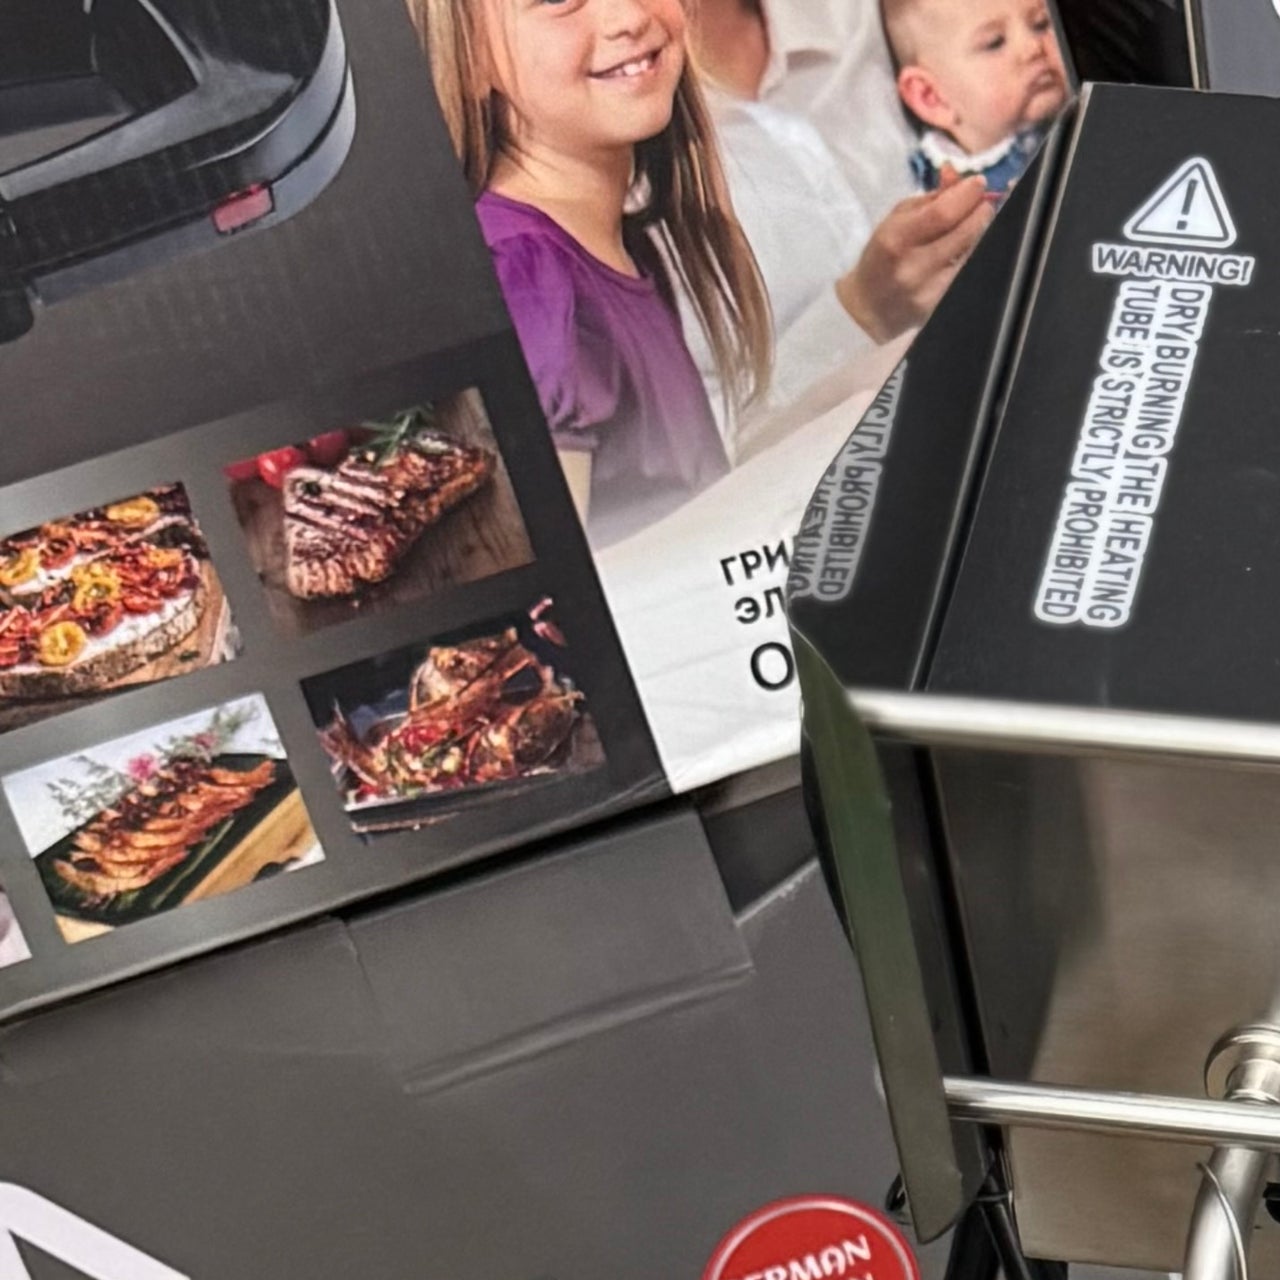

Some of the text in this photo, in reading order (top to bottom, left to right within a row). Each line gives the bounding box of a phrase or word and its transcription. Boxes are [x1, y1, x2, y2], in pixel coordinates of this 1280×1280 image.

[1096, 246, 1250, 283] WARNING!
[1040, 285, 1161, 618] TUBE IS STRICTLY PROHIBITED
[1085, 287, 1206, 622] DRY BURNING THE HEATING
